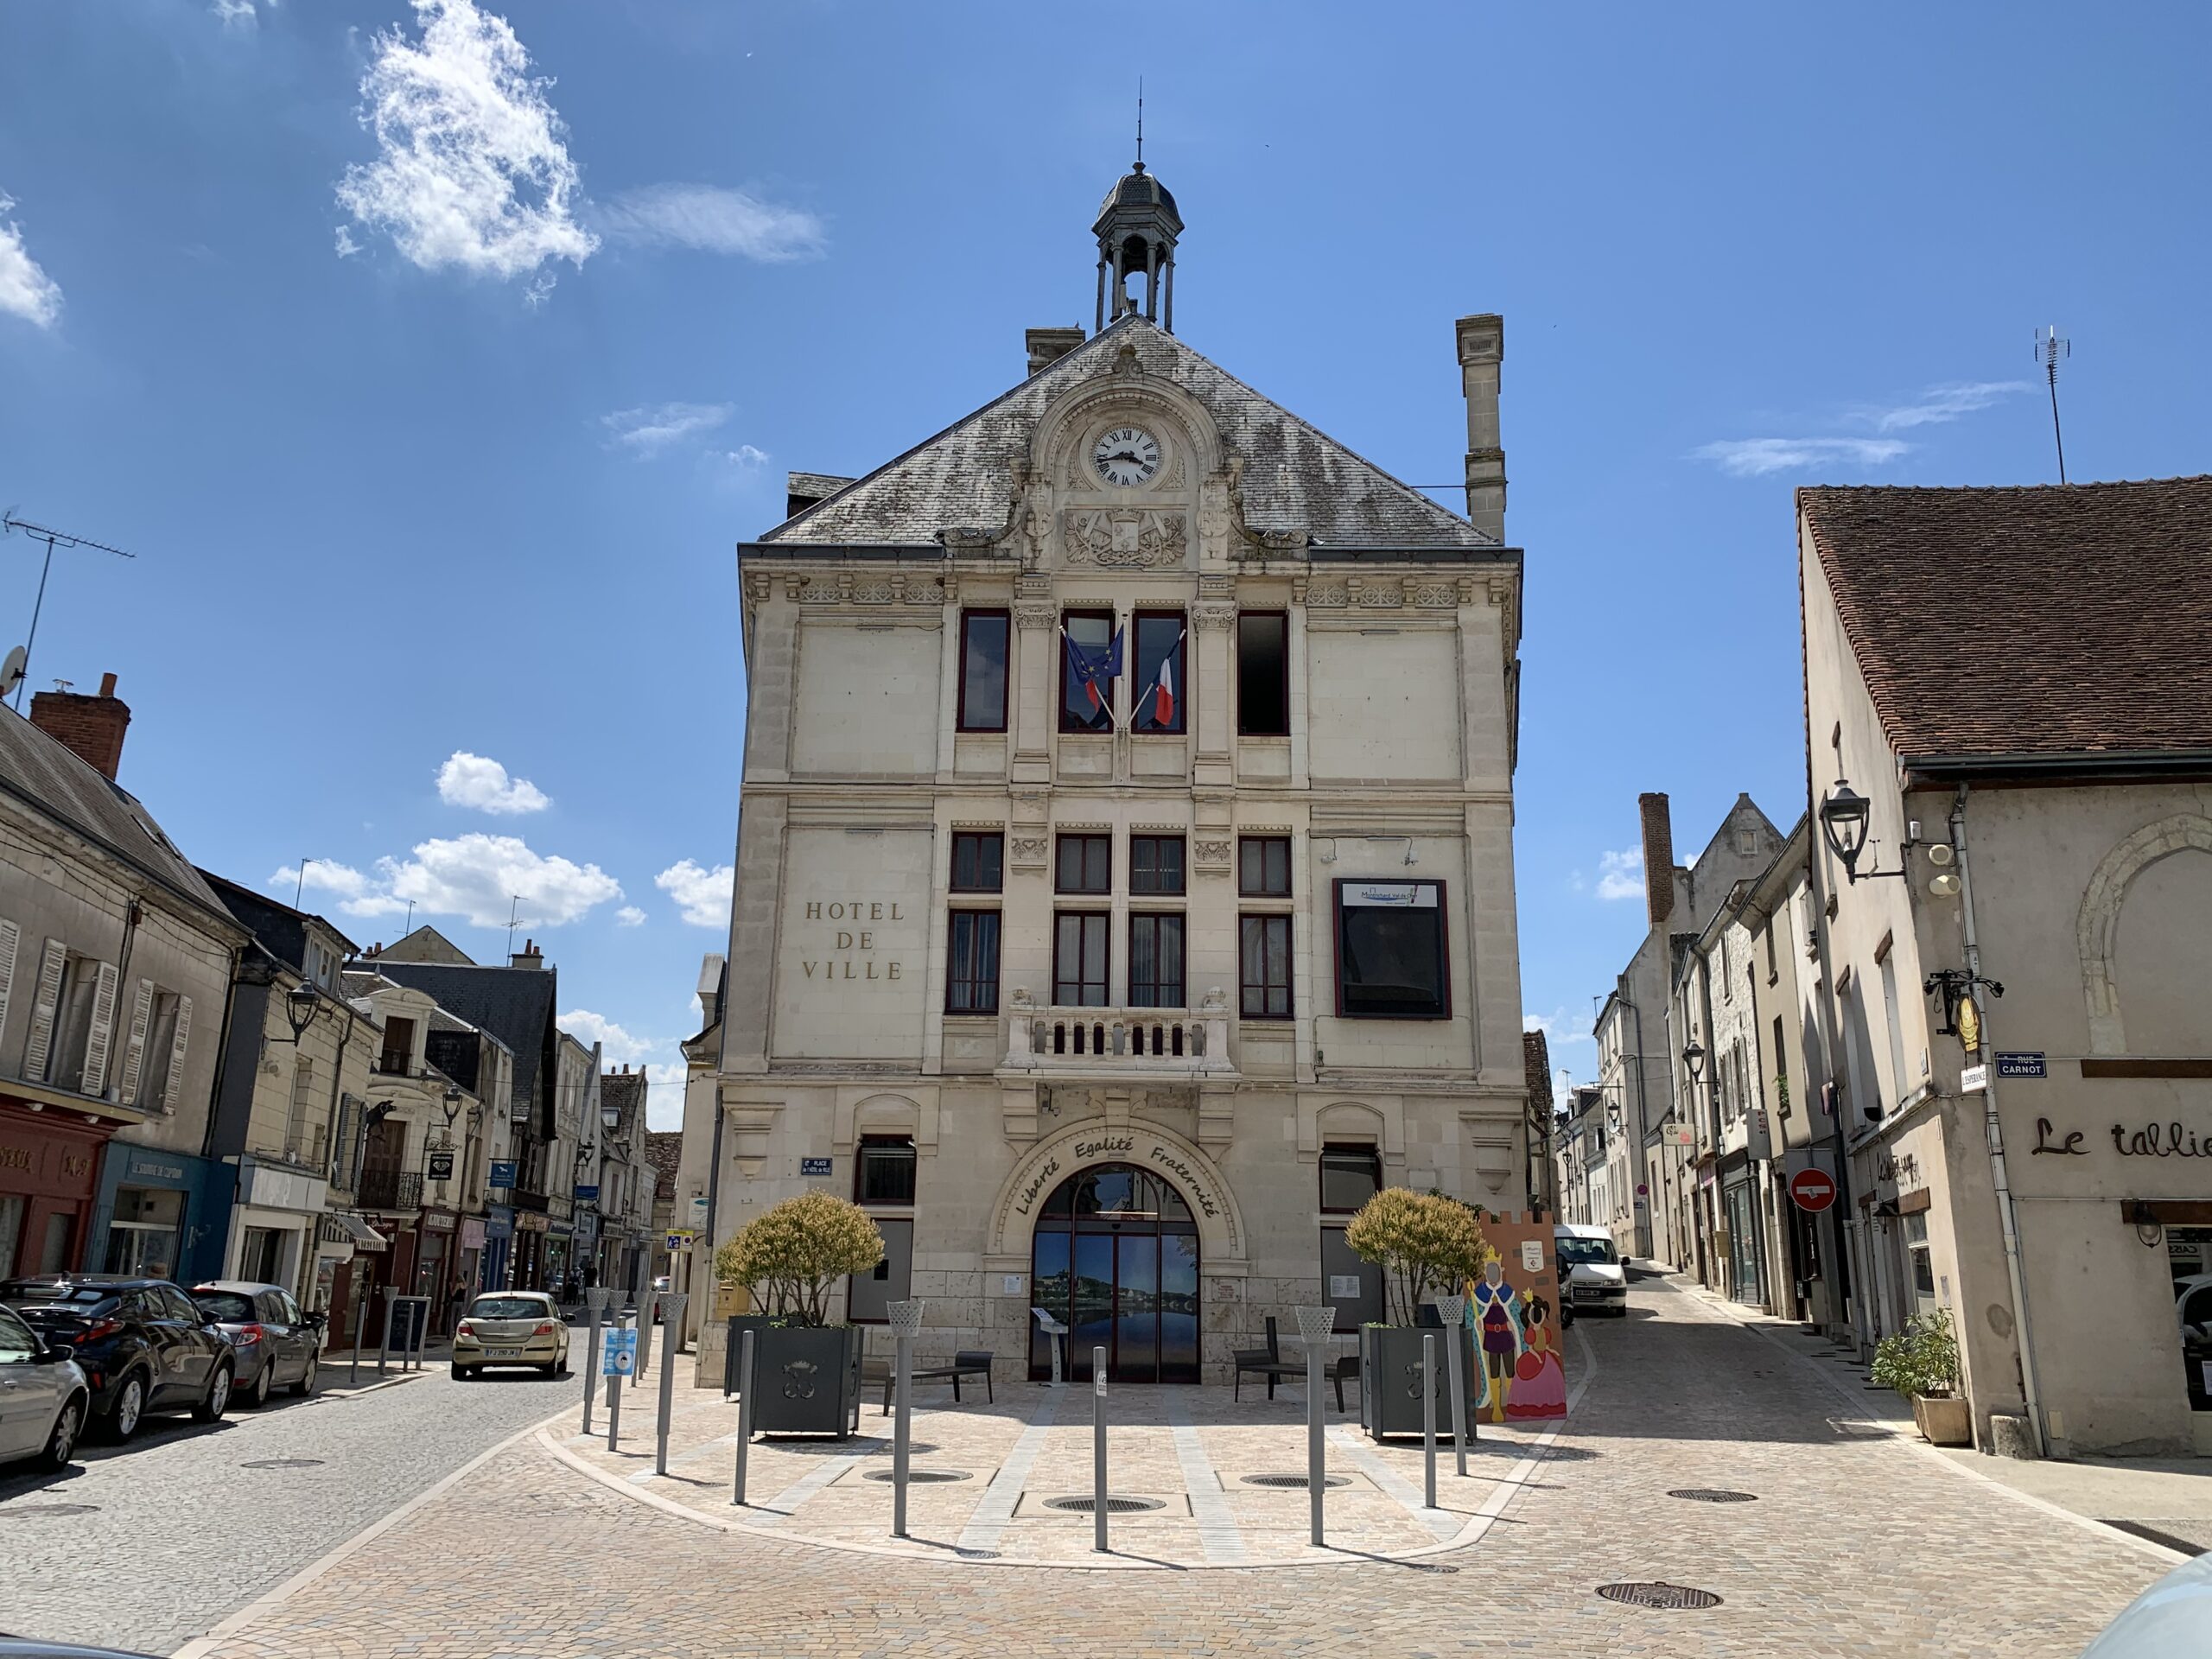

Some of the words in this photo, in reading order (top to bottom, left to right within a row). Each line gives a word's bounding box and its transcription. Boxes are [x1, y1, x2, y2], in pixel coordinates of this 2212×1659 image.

[805, 902, 905, 920] HOTEL
[836, 931, 873, 950] DE
[802, 961, 901, 980] VILLE
[2002, 1065, 2042, 1074] CARNOT
[2031, 1117, 2091, 1156] Le
[1016, 1157, 1060, 1216] Liberté
[1075, 1137, 1134, 1159] Egalité
[1150, 1147, 1220, 1218] Fraternité
